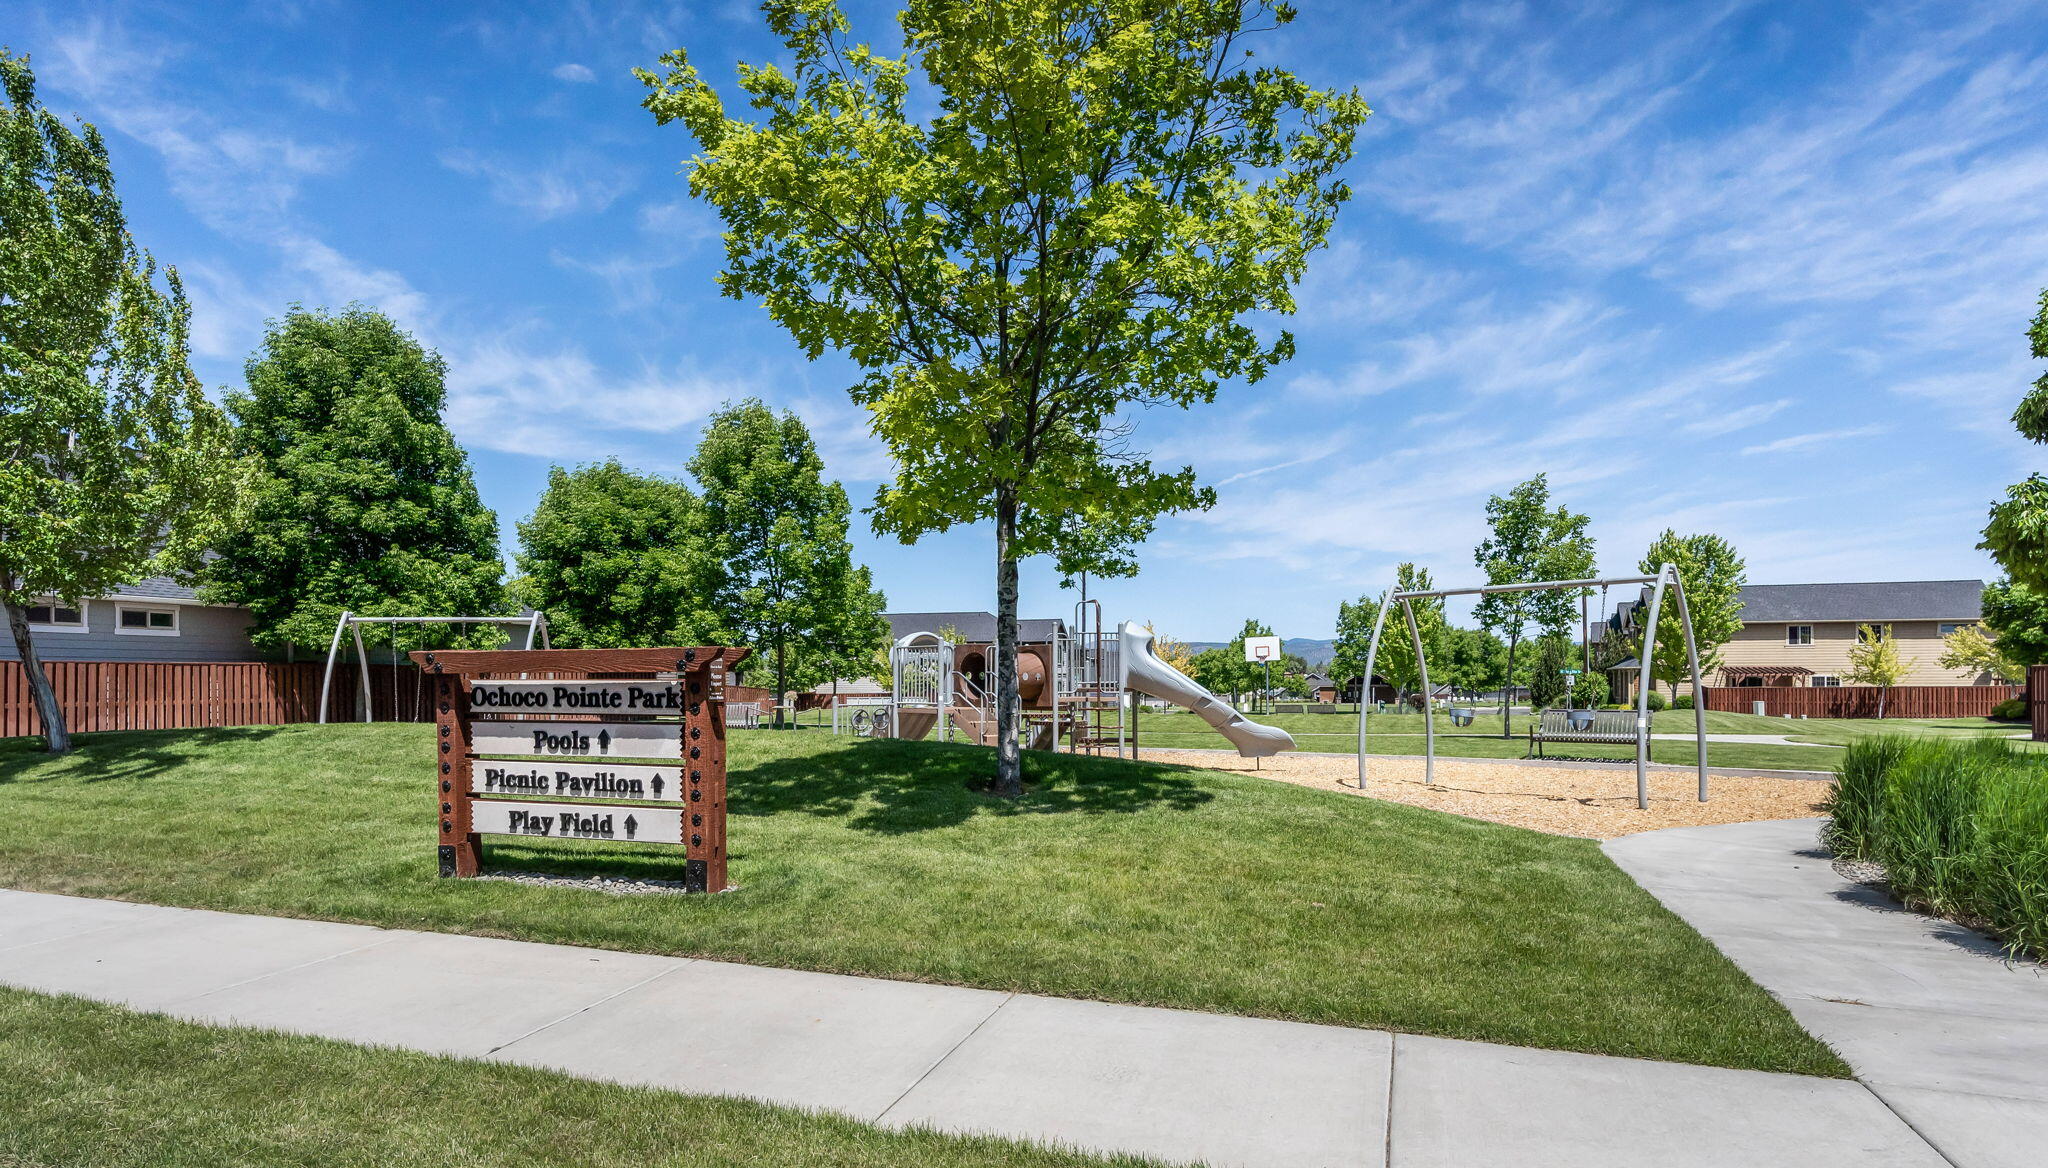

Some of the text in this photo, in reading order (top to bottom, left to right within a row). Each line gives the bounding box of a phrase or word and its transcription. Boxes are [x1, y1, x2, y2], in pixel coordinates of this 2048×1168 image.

[471, 687, 680, 708] Ochoco Pointe Park
[533, 730, 590, 750] Pools
[485, 768, 643, 793] Picnic Pavilion
[509, 810, 613, 835] Play Field
